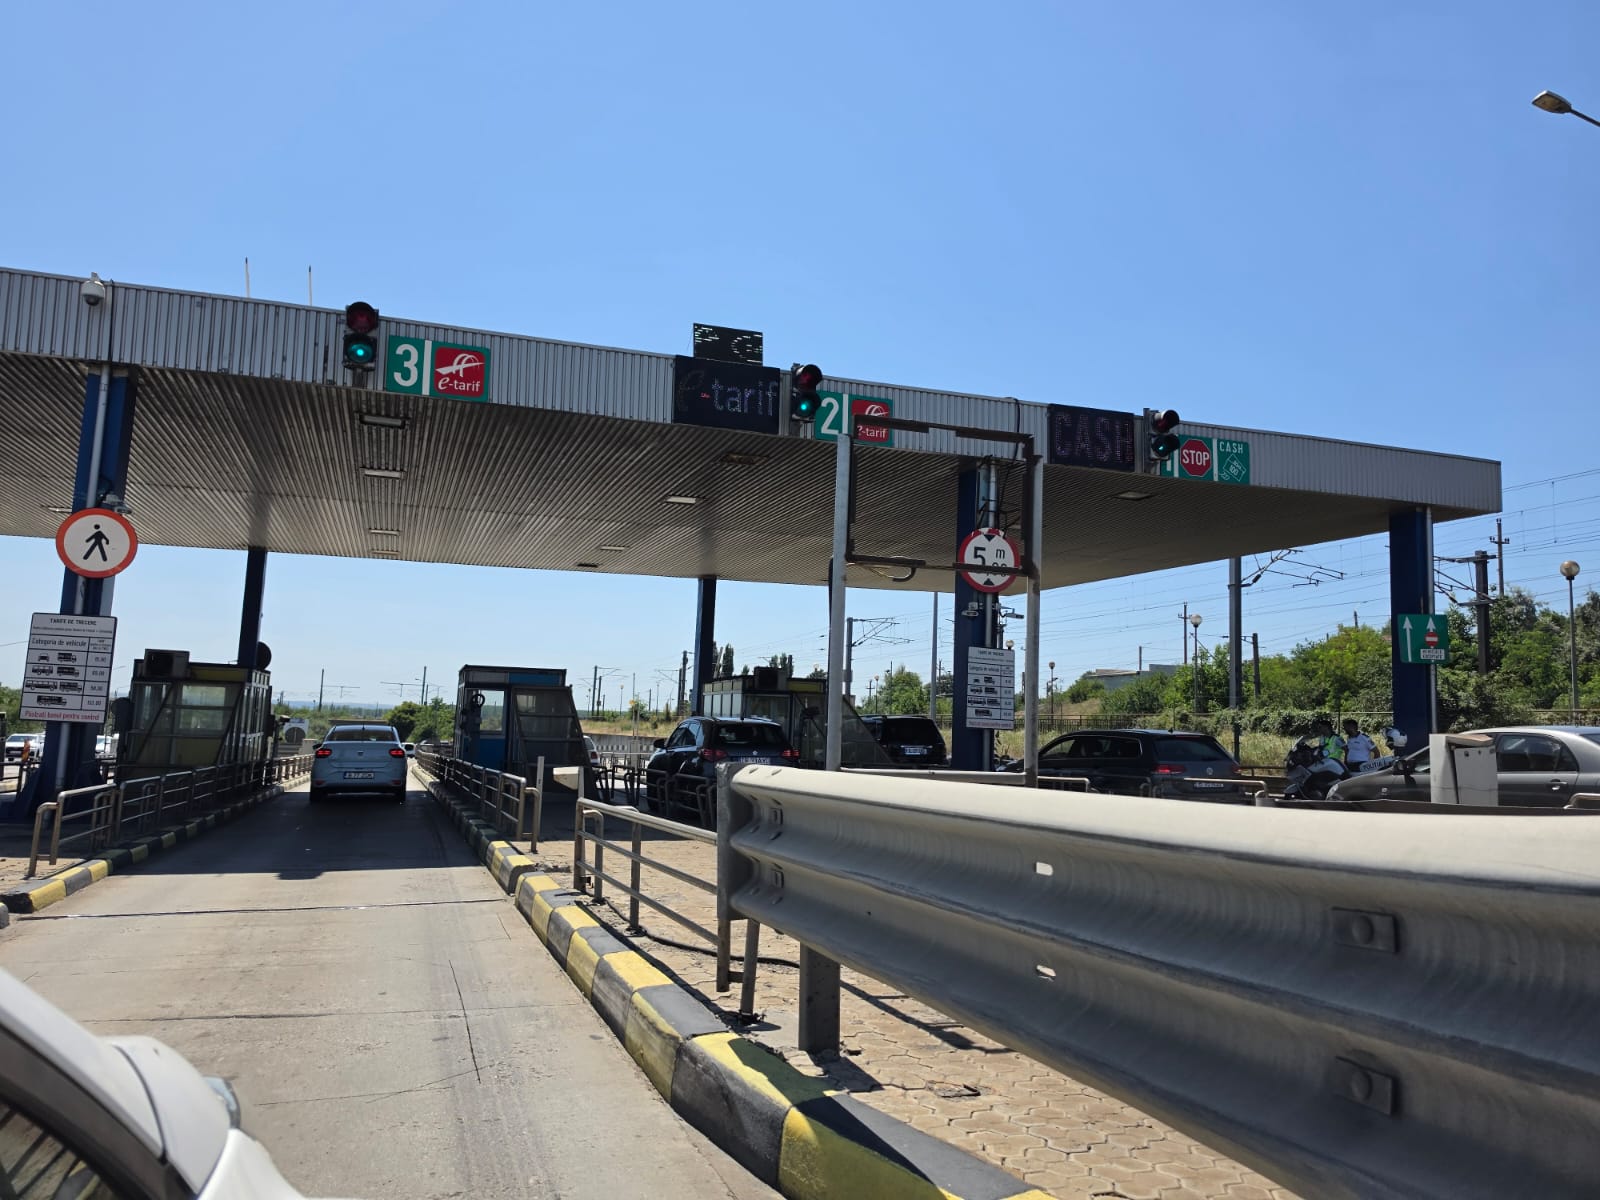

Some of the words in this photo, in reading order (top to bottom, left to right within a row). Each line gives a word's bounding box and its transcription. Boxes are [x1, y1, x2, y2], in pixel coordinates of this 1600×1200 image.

[394, 344, 419, 387] 3
[438, 376, 481, 392] e-tarif
[820, 397, 840, 435] 2
[1055, 413, 1135, 463] CASH
[1219, 441, 1244, 454] CASH
[1182, 449, 1210, 467] STOP
